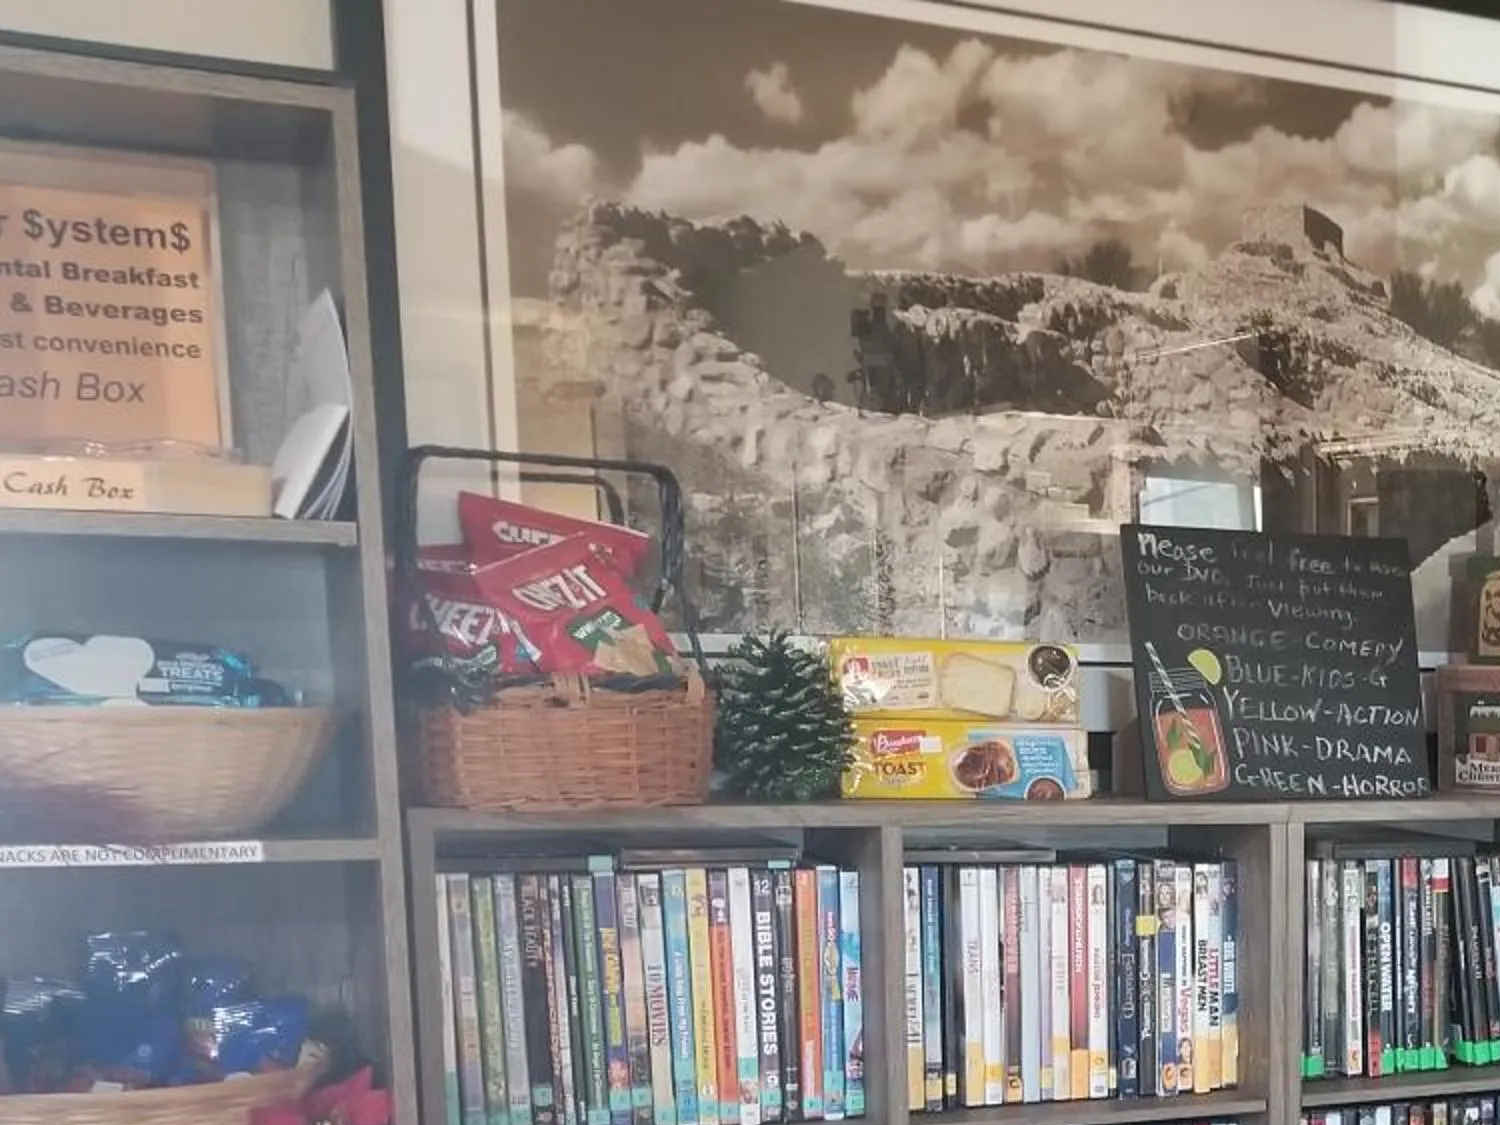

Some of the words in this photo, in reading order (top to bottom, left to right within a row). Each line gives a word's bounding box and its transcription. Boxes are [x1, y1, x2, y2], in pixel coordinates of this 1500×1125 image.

[23, 208, 190, 254] $ystem$
[62, 261, 199, 289] Breakfast
[11, 293, 32, 312] &
[45, 295, 203, 326] Beverages
[34, 333, 201, 358] convenience
[76, 372, 145, 403] Box
[4, 472, 67, 497] Cash
[83, 477, 135, 500] Box
[1137, 532, 1216, 563] Please
[873, 761, 928, 776] TOAST
[51, 850, 78, 862] ARE
[85, 848, 118, 862] NOT
[756, 911, 772, 968] BIBLE
[1379, 921, 1393, 961] OPEN
[1197, 985, 1207, 1011] MEN
[1380, 962, 1394, 1012] WATER
[649, 981, 665, 1047] MOVIES
[759, 974, 778, 1056] STORIES
[1209, 990, 1220, 1027] MAN
